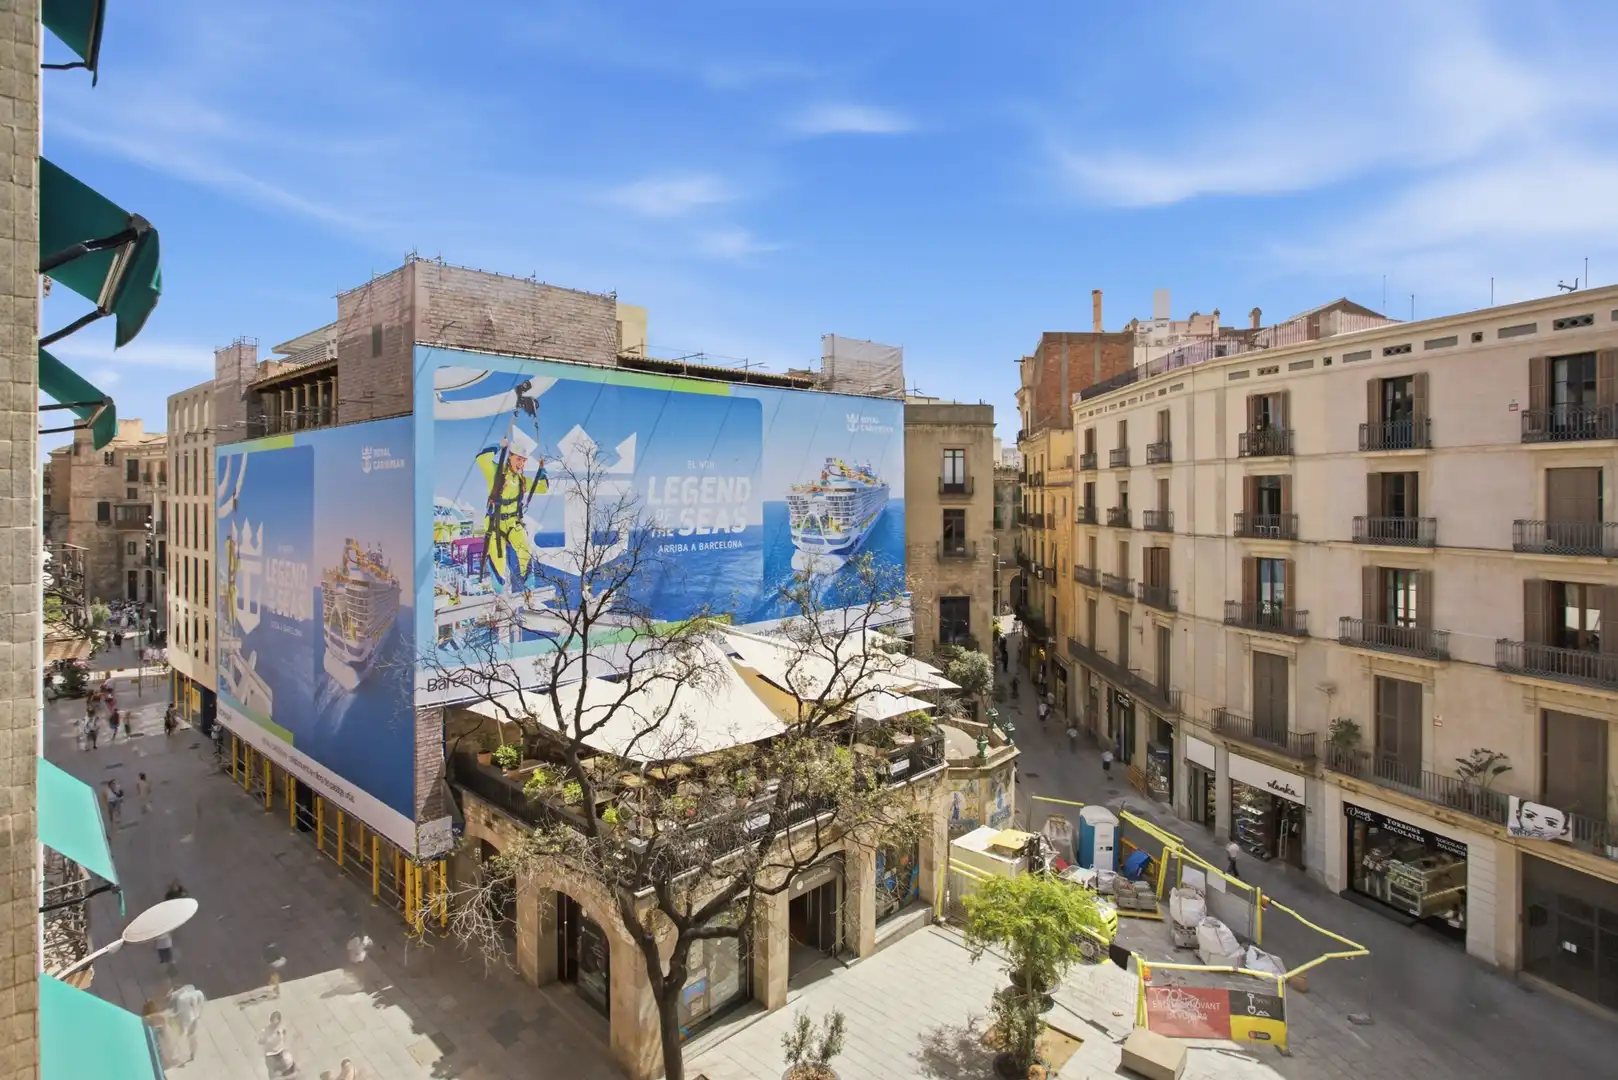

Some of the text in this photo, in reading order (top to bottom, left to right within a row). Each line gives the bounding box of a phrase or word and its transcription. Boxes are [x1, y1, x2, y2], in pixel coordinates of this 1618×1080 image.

[647, 476, 752, 504] LEGEND
[678, 507, 747, 536] SEAS
[658, 540, 743, 553] ARRIBA A BARCELONA
[266, 557, 307, 590] LEGEND
[427, 672, 499, 692] Barceloa
[1387, 818, 1420, 834] TORRONS
